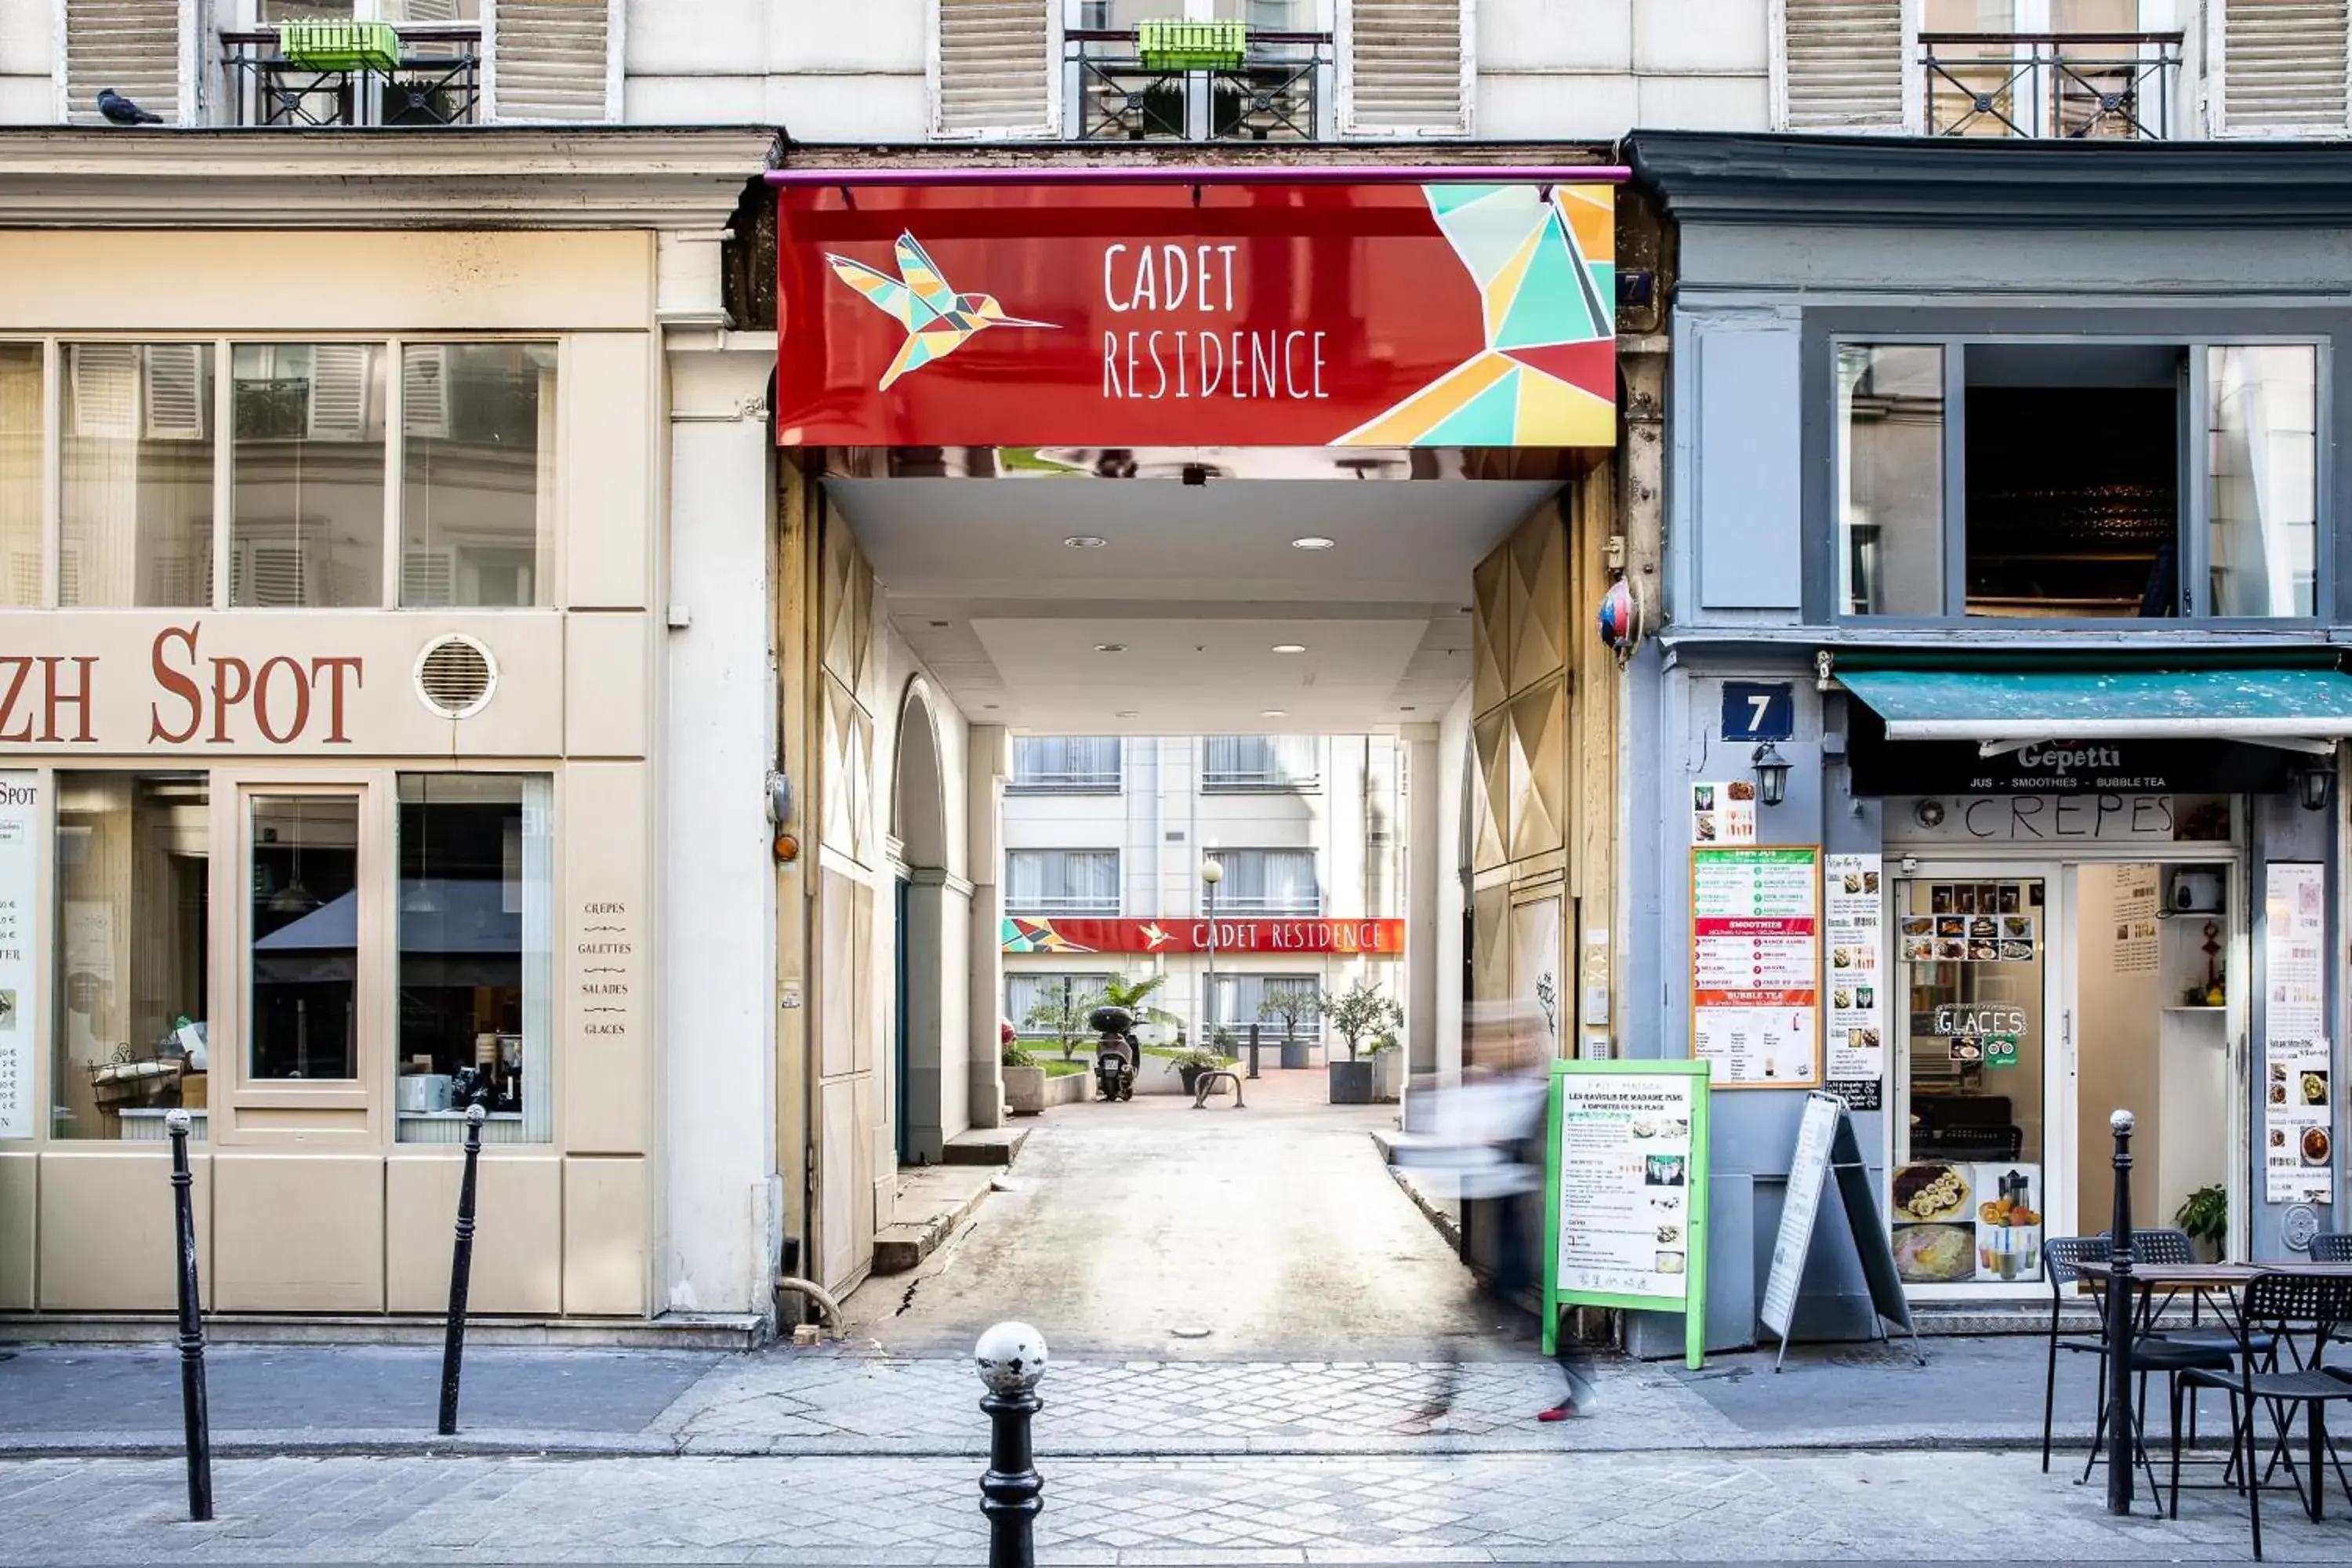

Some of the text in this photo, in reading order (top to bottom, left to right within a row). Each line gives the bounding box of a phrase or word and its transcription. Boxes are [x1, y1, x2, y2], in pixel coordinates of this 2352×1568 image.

[1104, 244, 1237, 311] CADET
[1625, 275, 1639, 299] 7
[1103, 329, 1329, 399] RESIDENCE
[147, 621, 362, 744] SPOT
[1748, 695, 1770, 731] 7
[2017, 745, 2121, 775] Gepetti
[1970, 777, 2166, 788] JUS SMOOTHIES BUBBLE TEA
[1965, 793, 2172, 838] CREPES
[1192, 923, 1381, 948] CADET RESIDENCE
[578, 943, 631, 954] GALETTES
[582, 984, 628, 995] SALADES
[1726, 991, 1762, 1000] BUBBLE
[584, 1023, 625, 1035] GLACES
[1940, 1011, 2023, 1033] GLACES
